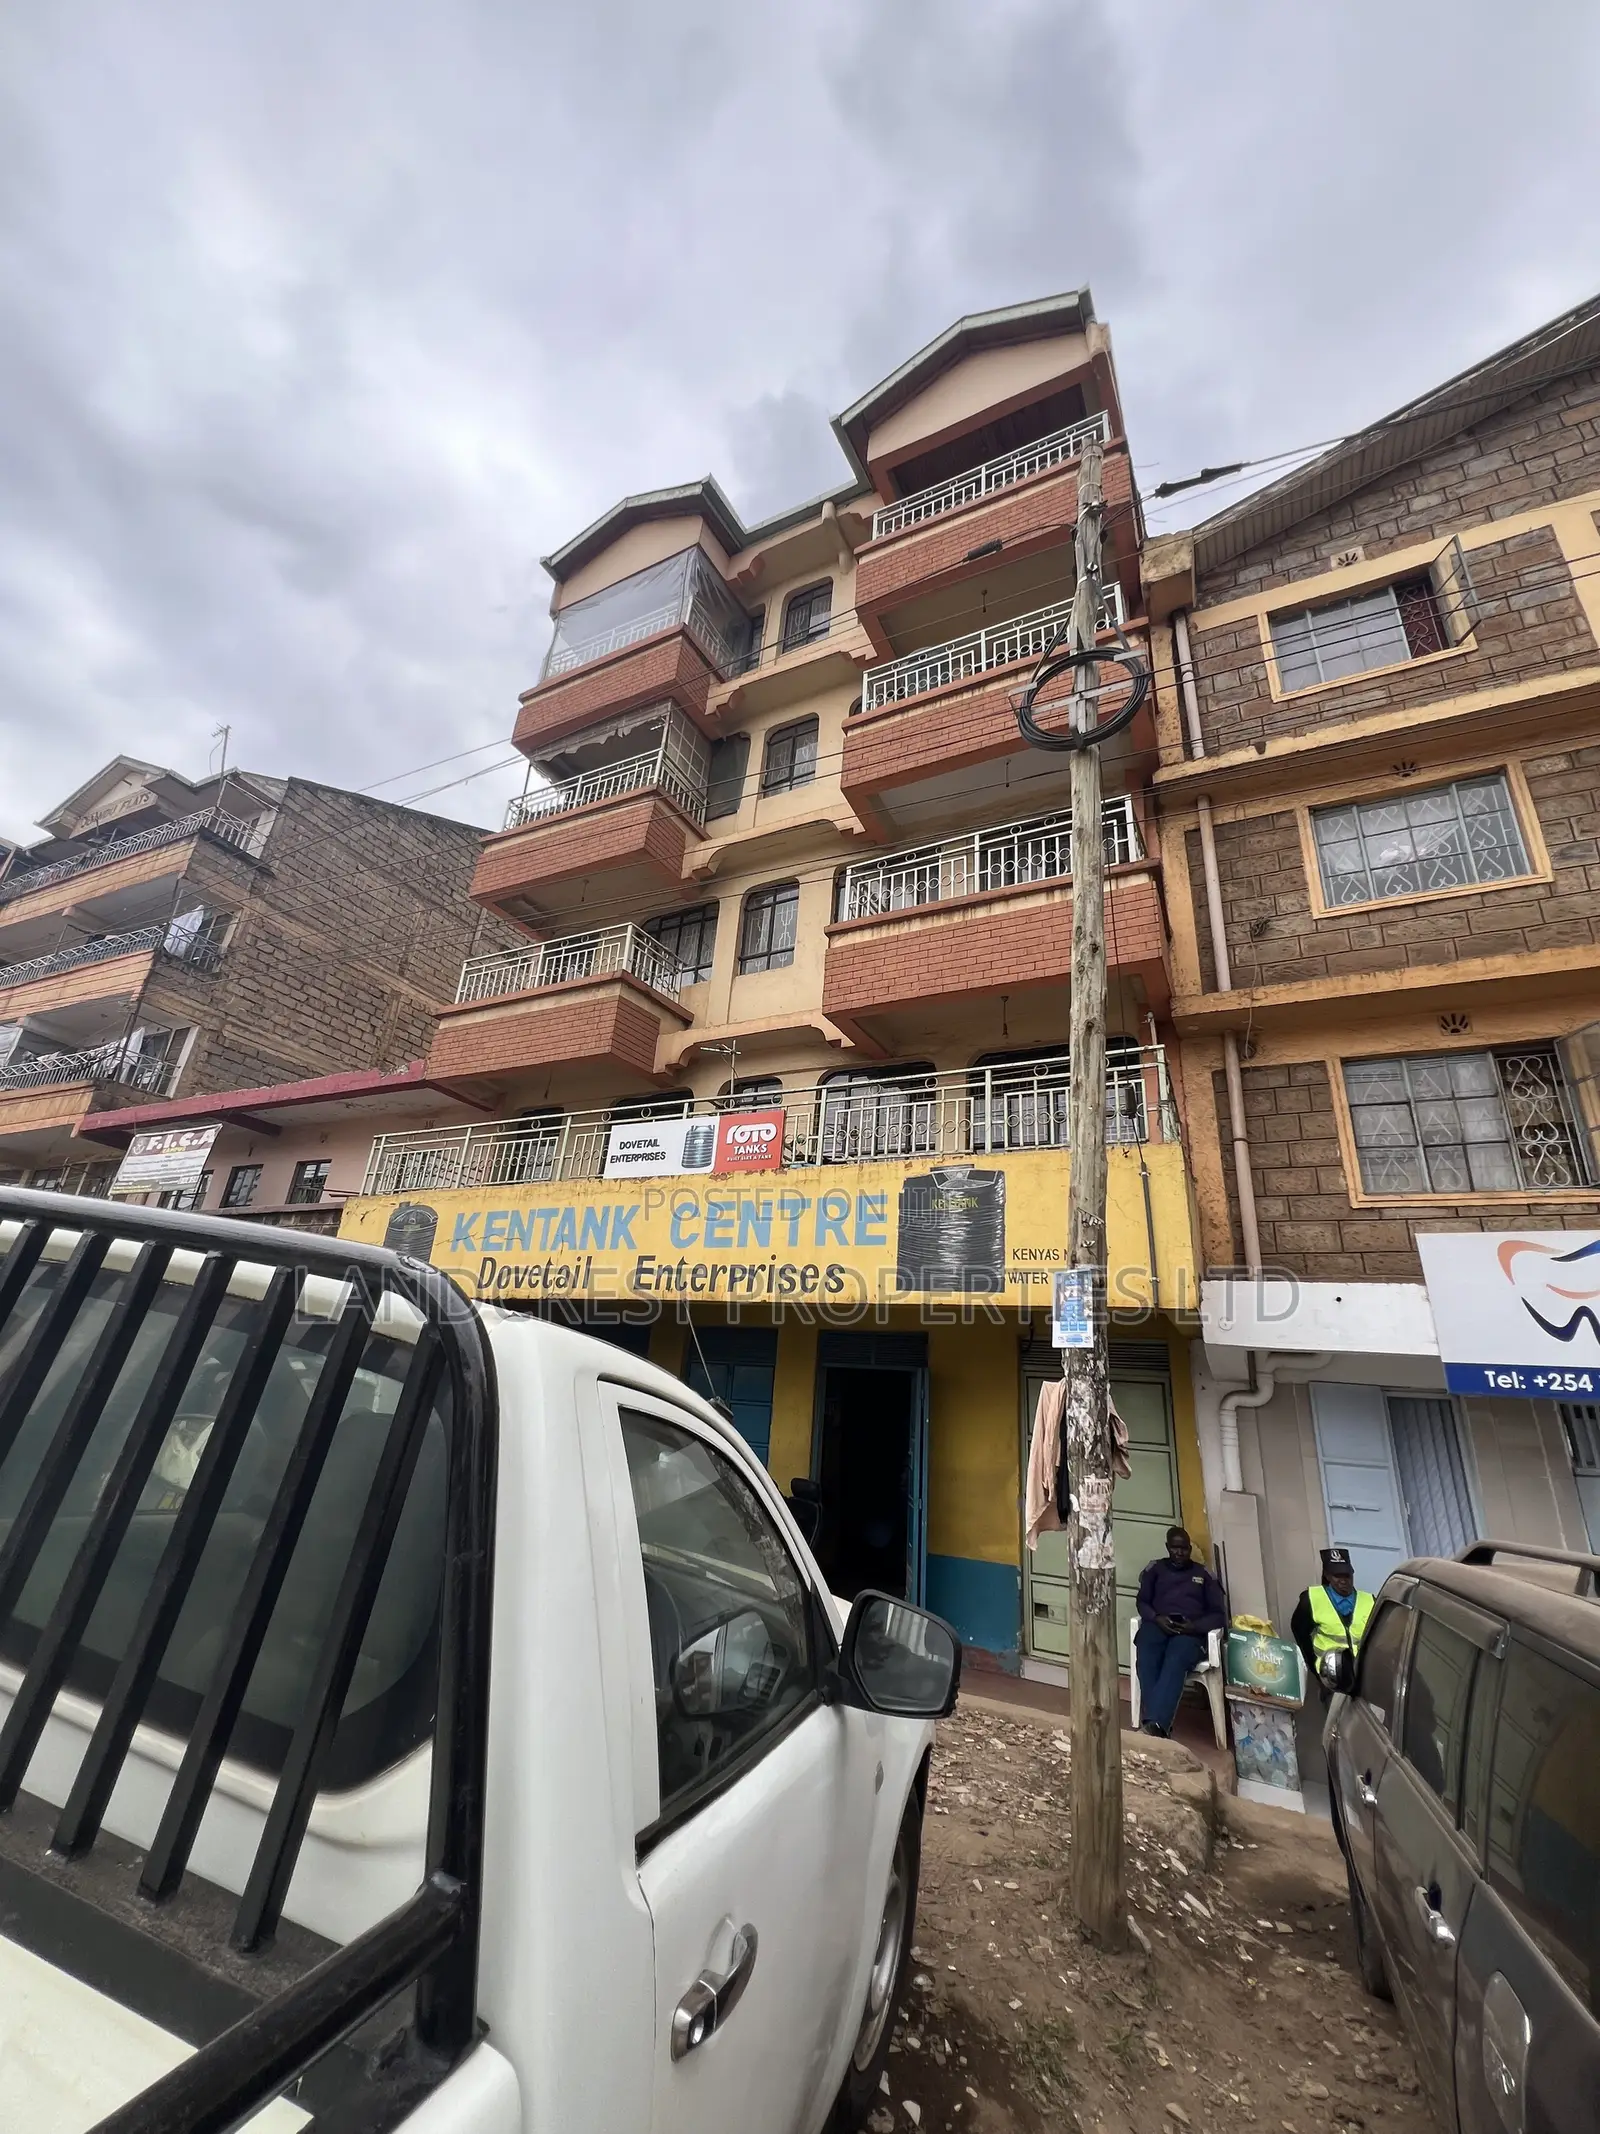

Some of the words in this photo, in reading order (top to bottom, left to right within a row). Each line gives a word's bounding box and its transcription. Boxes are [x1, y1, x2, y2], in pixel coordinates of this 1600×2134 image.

[619, 1138, 660, 1150] DOVETAIL
[734, 1143, 768, 1154] TANKS
[610, 1151, 666, 1163] ENTERPRISES
[451, 1205, 641, 1252] KENTANK
[669, 1194, 888, 1249] CENTRE
[1012, 1248, 1060, 1261] KENYAS
[477, 1255, 593, 1290] Dovetail
[633, 1254, 846, 1294] Enterprises
[1008, 1271, 1049, 1285] WATER
[1484, 1370, 1526, 1389] Tel:
[1533, 1372, 1594, 1392] +254
